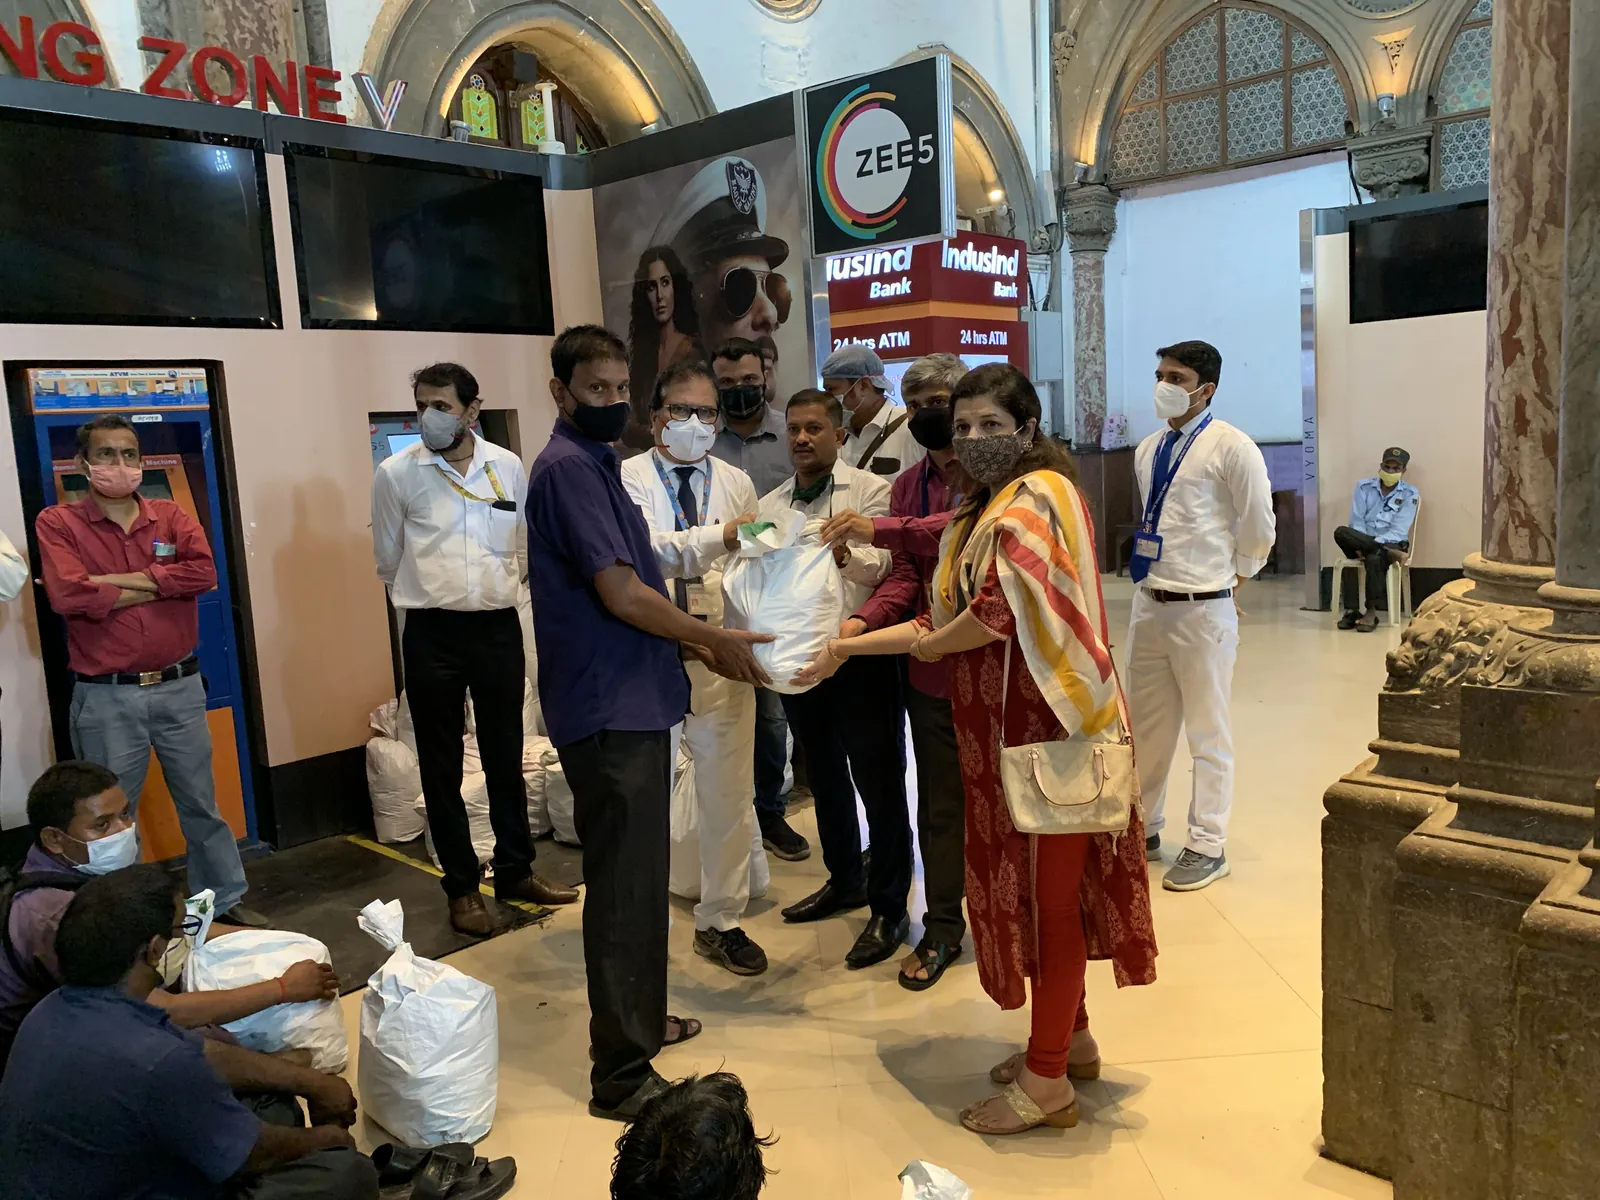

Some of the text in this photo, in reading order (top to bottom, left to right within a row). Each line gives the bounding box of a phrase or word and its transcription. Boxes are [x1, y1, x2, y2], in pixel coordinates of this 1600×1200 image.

[138, 35, 347, 125] ZONE
[855, 133, 934, 178] ZEE5
[826, 245, 914, 281] usInd
[941, 239, 1019, 277] IndusInd
[869, 276, 912, 299] Bank
[993, 281, 1018, 298] Bank
[878, 330, 910, 349] ATM
[960, 329, 1008, 345] 24 hrs ATM
[1304, 416, 1315, 480] VYOMA
